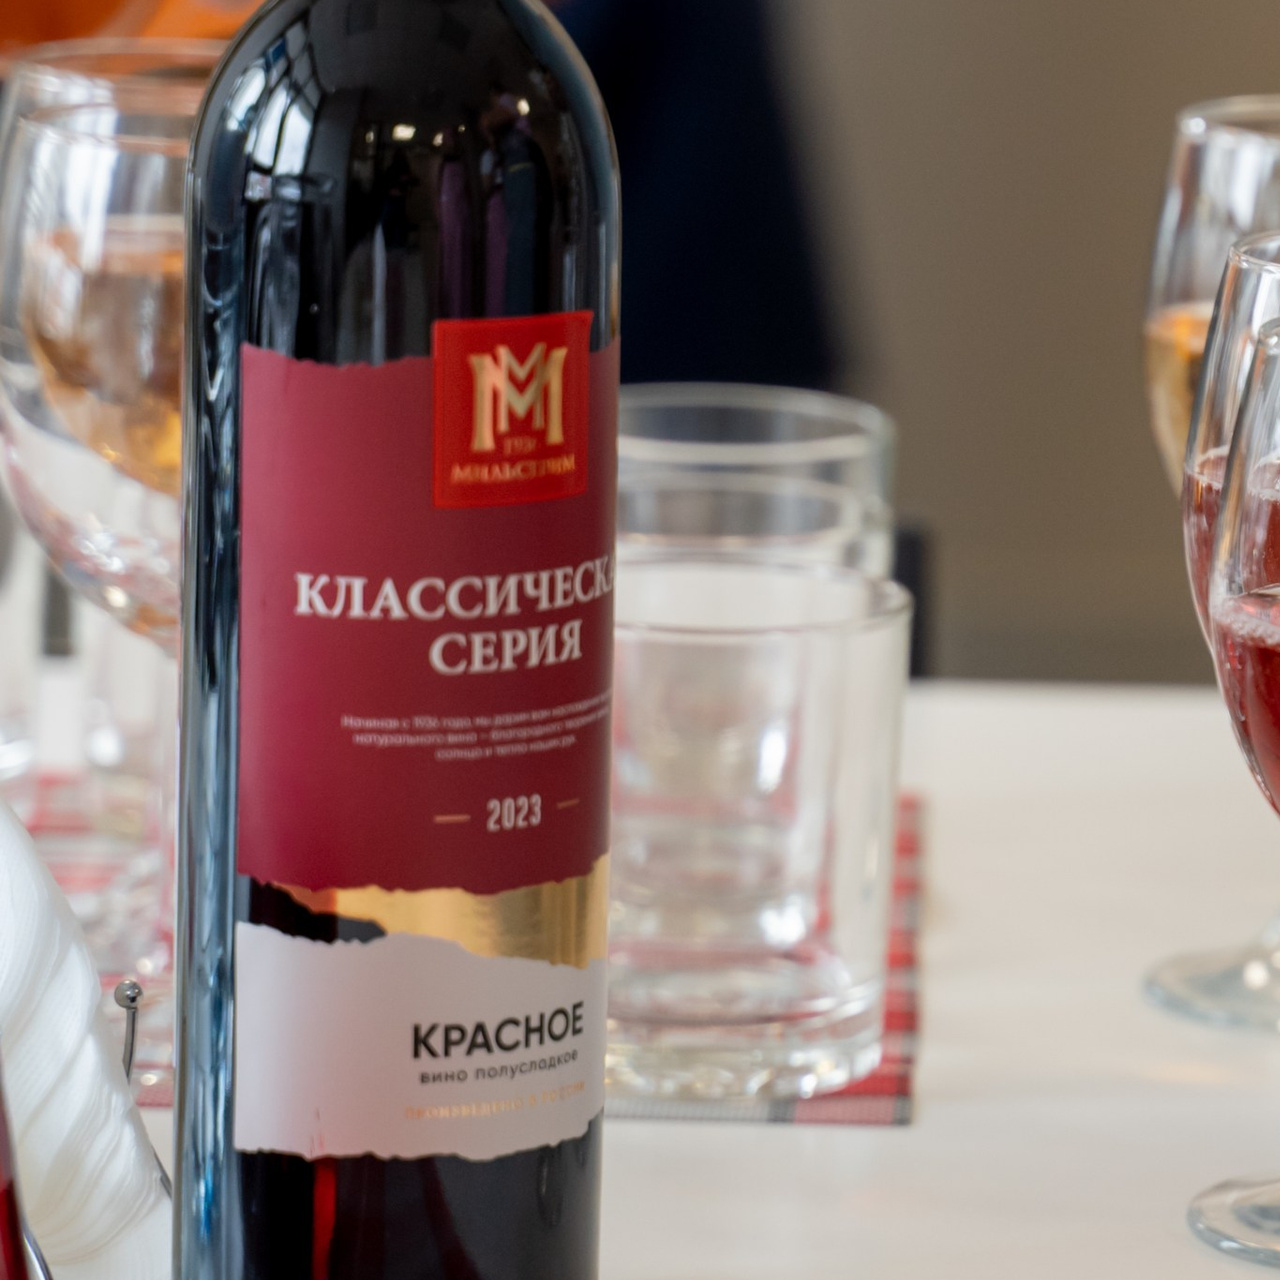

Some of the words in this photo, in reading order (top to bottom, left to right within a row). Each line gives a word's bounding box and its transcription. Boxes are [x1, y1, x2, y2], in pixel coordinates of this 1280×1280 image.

[428, 619, 583, 676] СЕРИЯ
[486, 793, 542, 832] 2023
[412, 1000, 584, 1059] КРАСНОЕ
[420, 1070, 468, 1084] вино
[475, 1049, 578, 1081] полусладкое
